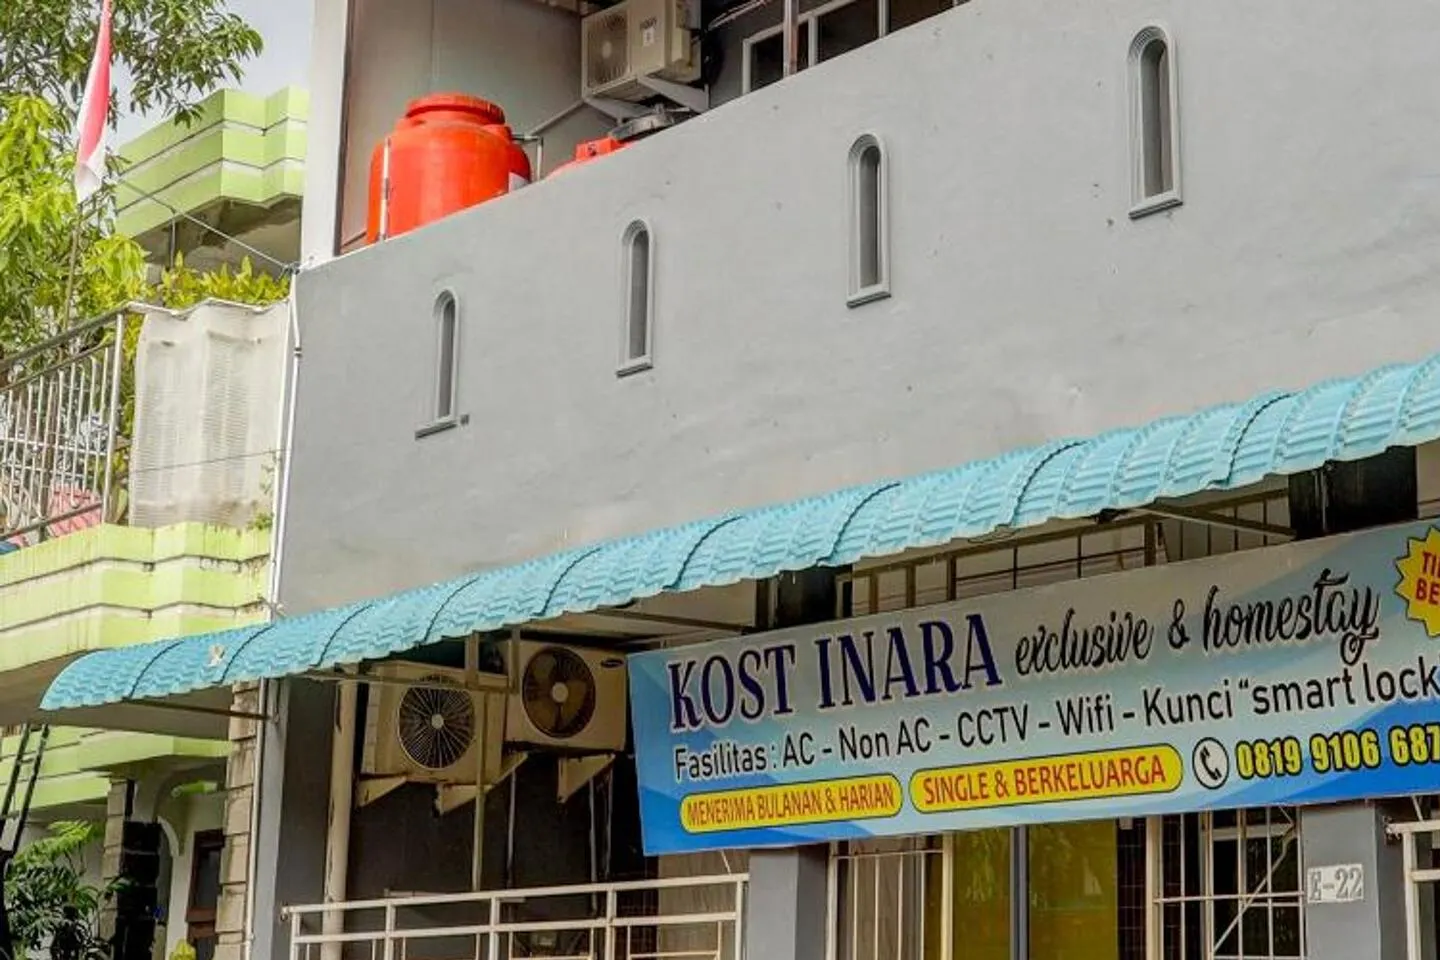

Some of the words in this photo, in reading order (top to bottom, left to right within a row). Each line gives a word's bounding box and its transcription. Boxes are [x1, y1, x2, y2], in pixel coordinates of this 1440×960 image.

[667, 644, 797, 730] KOST
[814, 613, 1004, 710] INARA
[1014, 606, 1155, 676] exclusive
[1167, 598, 1191, 650] &
[1203, 567, 1381, 666] homestay
[782, 731, 817, 769] AC
[839, 725, 890, 762] Non
[896, 716, 932, 756] AC
[957, 703, 1029, 748] CCTV
[1055, 693, 1114, 736] Wifi
[1143, 678, 1234, 727] Kunci
[923, 774, 990, 805] SINGLE
[994, 769, 1010, 799] &
[1013, 753, 1167, 798] BERKELUARGA
[1235, 735, 1303, 780] 0819
[1309, 728, 1382, 774] 9106
[687, 796, 755, 827] MENERIMA
[757, 787, 823, 821] BULANAN
[824, 786, 838, 814] &
[840, 780, 895, 809] HARIAN
